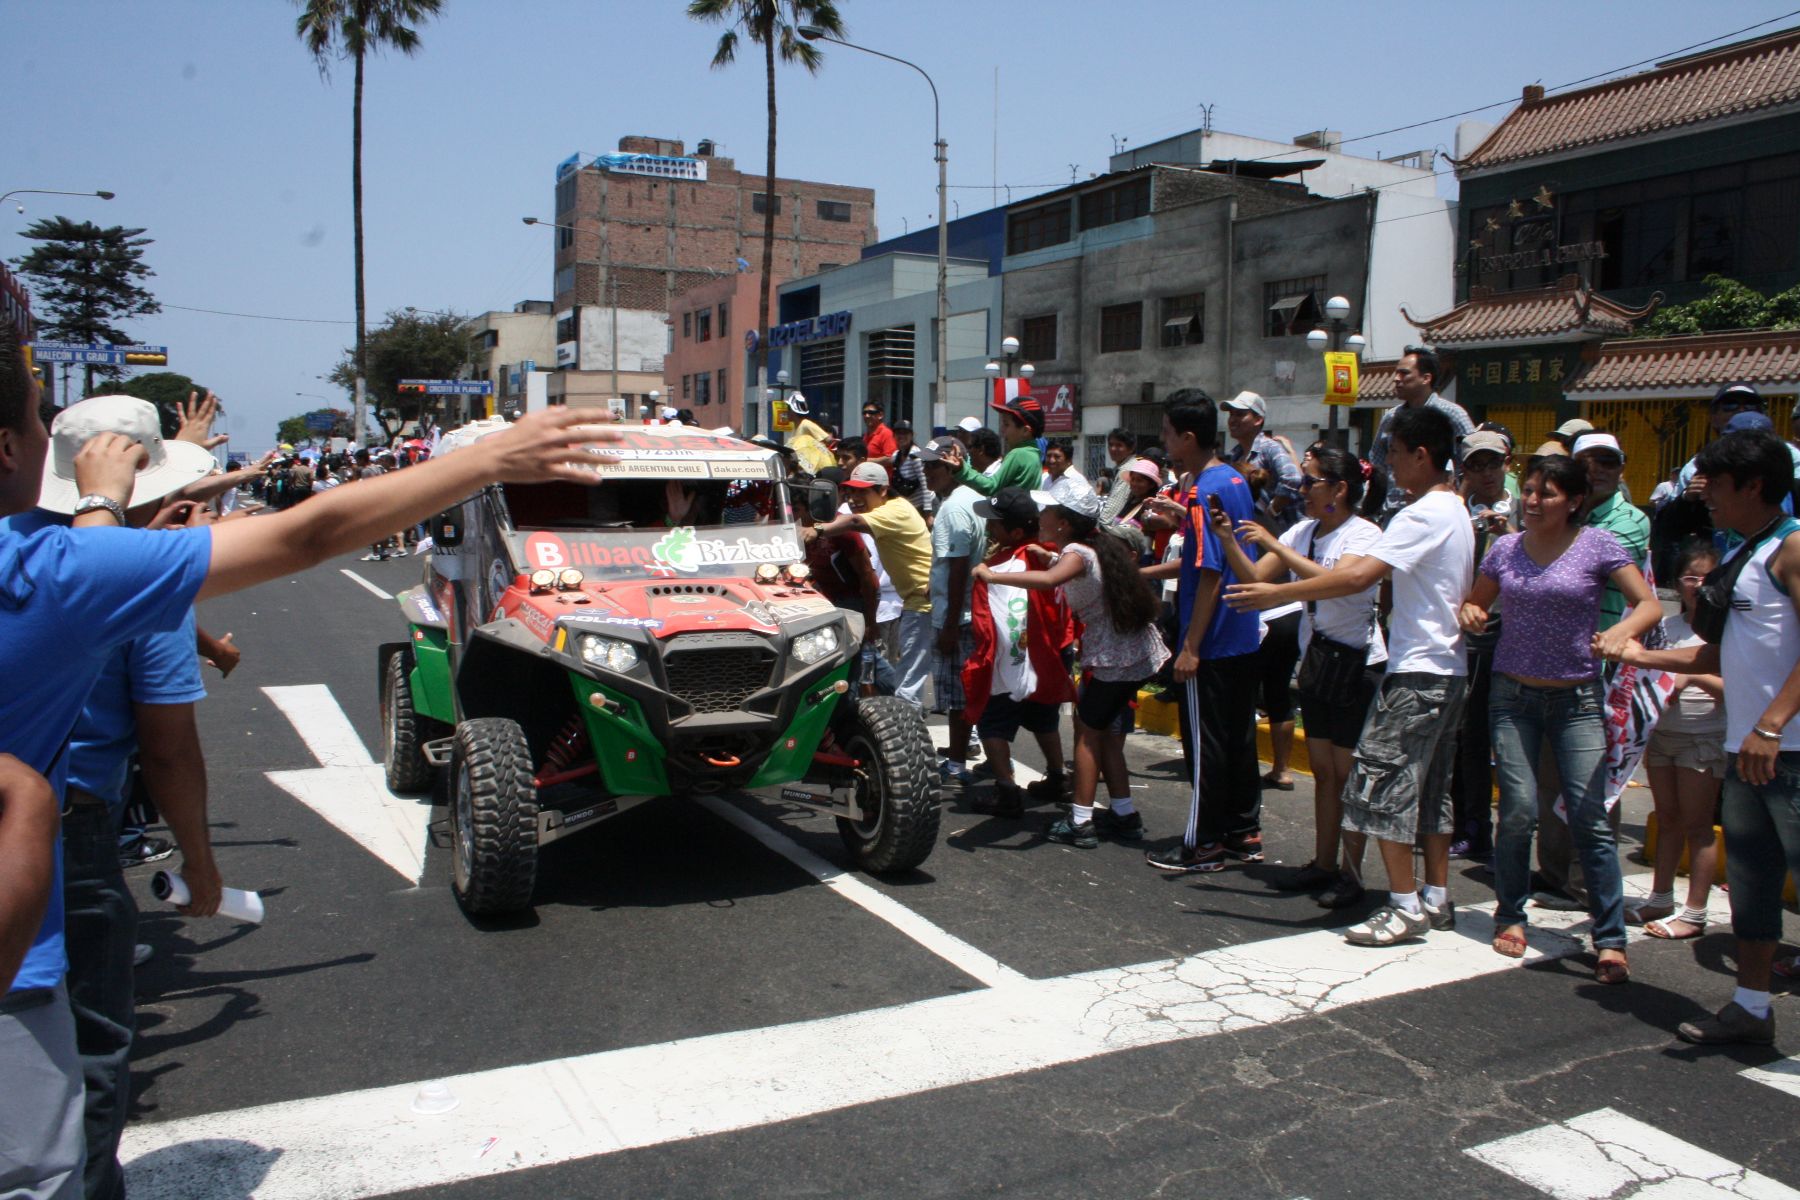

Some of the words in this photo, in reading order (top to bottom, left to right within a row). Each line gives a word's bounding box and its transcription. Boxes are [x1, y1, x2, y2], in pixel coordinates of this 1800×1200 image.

[86, 352, 108, 362] GRAU
[628, 464, 677, 473] ARGENTINA
[678, 465, 702, 473] CHILE
[713, 465, 766, 473] dakar.com
[534, 541, 651, 567] Bilbao
[697, 537, 800, 563] Bizkaia
